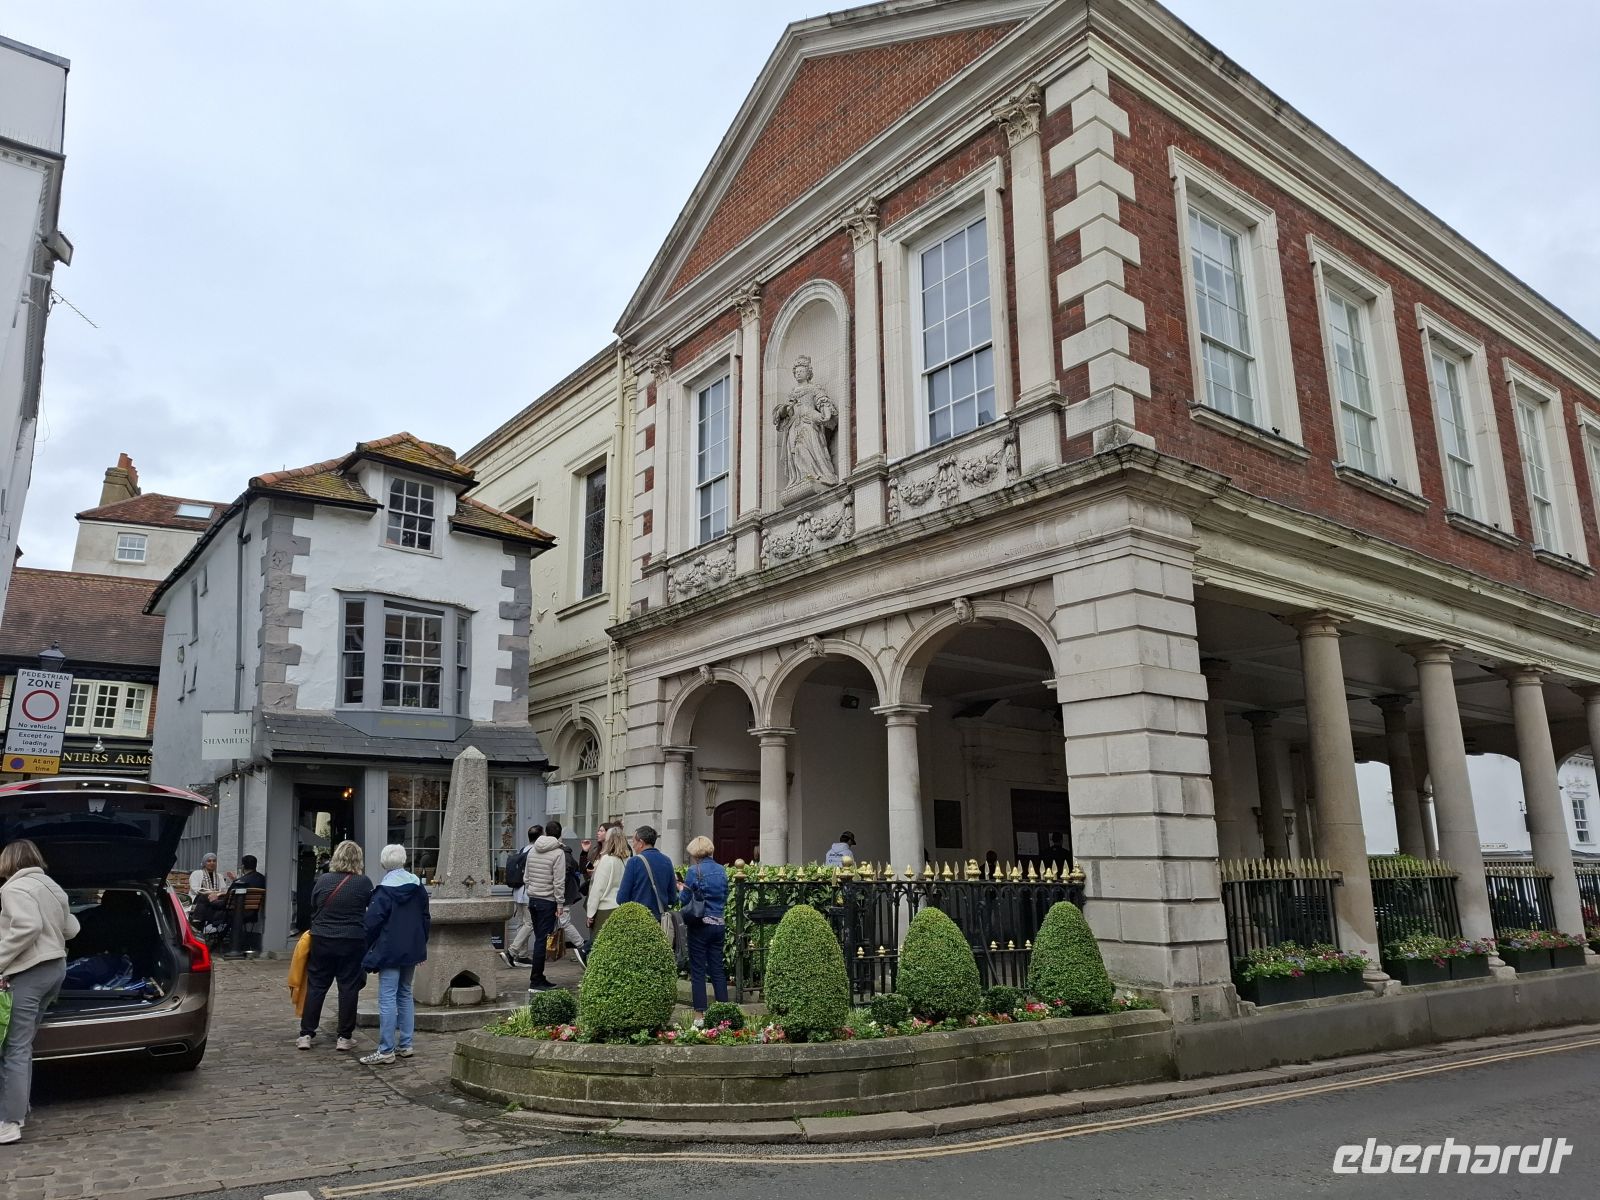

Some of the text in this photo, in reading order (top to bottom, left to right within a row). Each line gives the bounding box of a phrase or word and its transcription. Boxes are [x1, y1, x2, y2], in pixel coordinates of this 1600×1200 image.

[21, 670, 70, 681] PEDESTRIAN
[27, 679, 62, 689] ZONE
[18, 731, 42, 739] Except
[22, 739, 48, 747] loading
[115, 753, 153, 765] ARMS
